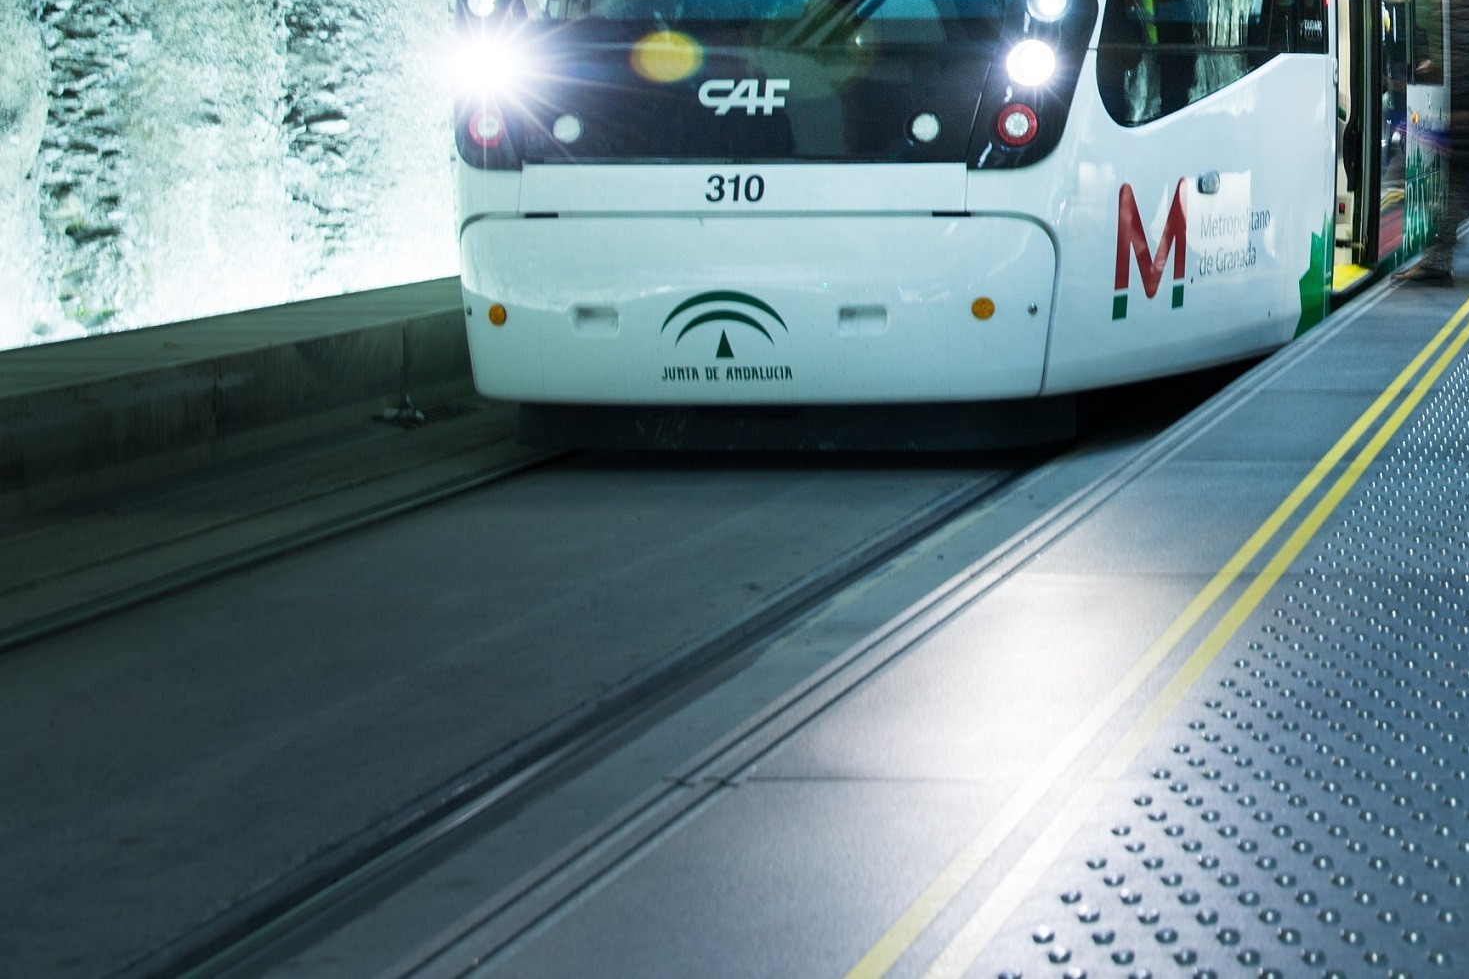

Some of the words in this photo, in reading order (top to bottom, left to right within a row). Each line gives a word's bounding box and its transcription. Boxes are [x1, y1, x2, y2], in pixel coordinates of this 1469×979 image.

[698, 78, 791, 116] CAF
[705, 174, 765, 204] 310
[1200, 207, 1271, 239] Metropolitano
[1112, 176, 1188, 320] M
[1199, 254, 1213, 276] de
[1216, 246, 1257, 273] Granada
[661, 366, 699, 381] JUNTA
[705, 366, 720, 381] DE
[726, 365, 793, 381] ANDALUCIA
